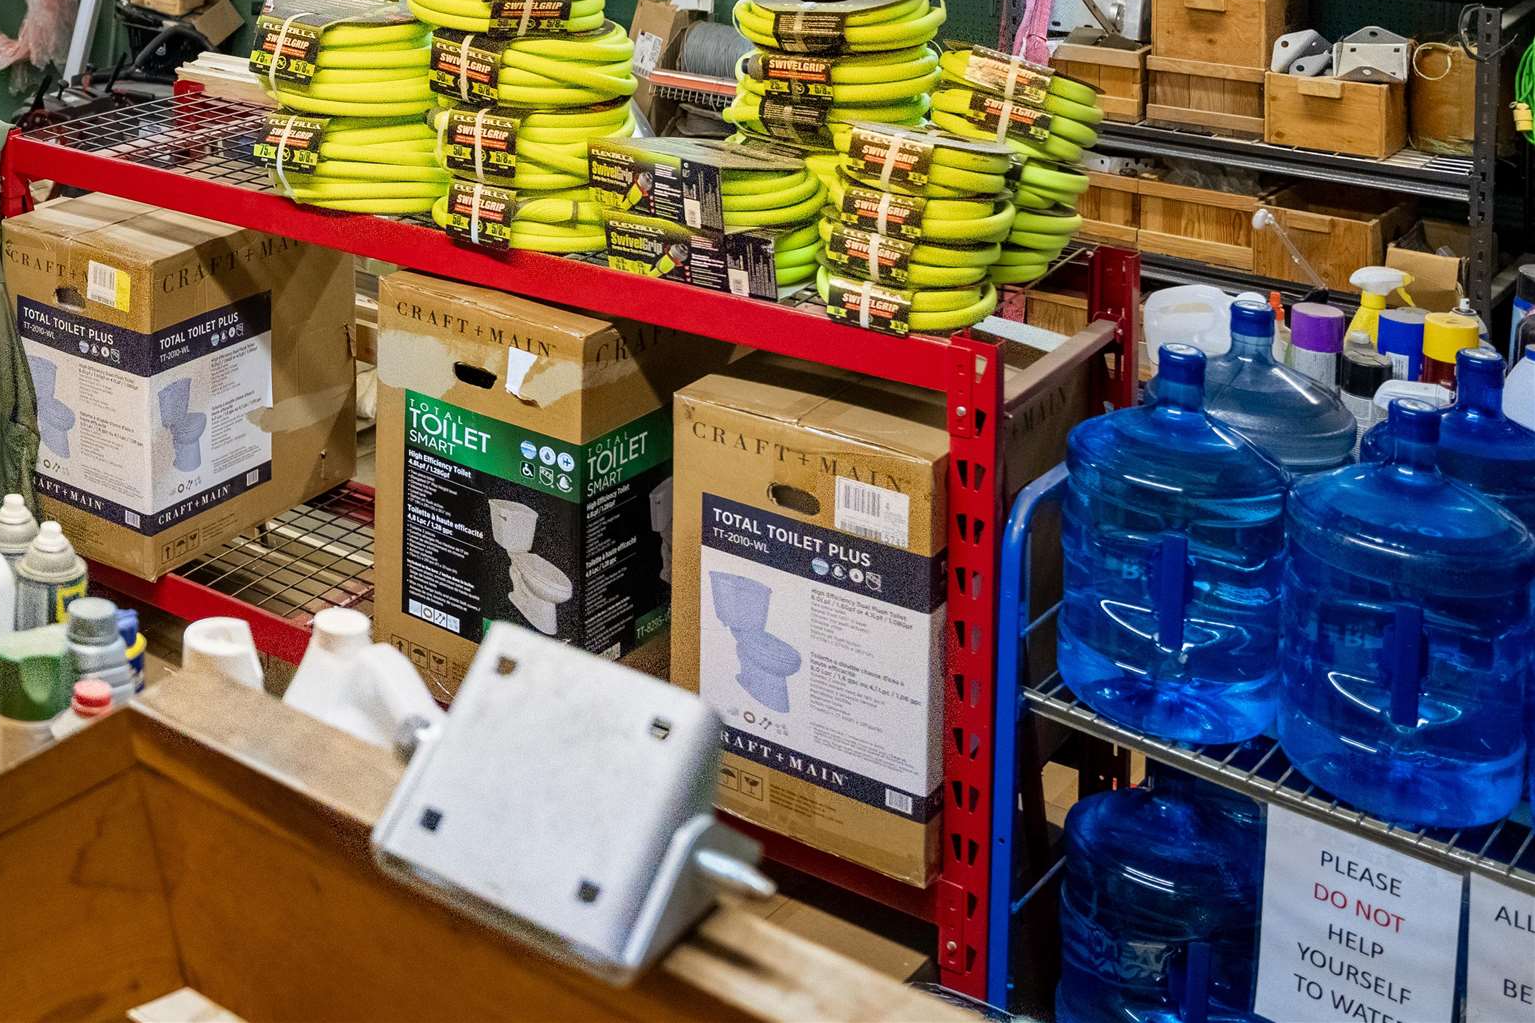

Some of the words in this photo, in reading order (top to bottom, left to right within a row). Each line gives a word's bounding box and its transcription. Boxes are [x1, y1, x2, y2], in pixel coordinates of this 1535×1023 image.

[768, 59, 826, 72] SWIVELGRIP
[591, 161, 633, 183] SwivelGrip
[610, 232, 663, 254] SwivelGrip
[23, 307, 51, 326] TOTAL
[52, 317, 86, 337] TOILET
[88, 329, 114, 345] PLUS
[159, 332, 186, 350] TOTAL
[187, 320, 217, 340] TOILET
[218, 312, 239, 327] PLUS
[397, 301, 469, 334] CRAFT
[489, 327, 551, 358] MAIN
[409, 398, 463, 424] TOTAL
[409, 407, 491, 453] TOILET
[409, 429, 456, 456] SMART
[587, 431, 630, 458] TOTAL
[693, 421, 790, 462] CRAFT
[408, 449, 423, 462] High
[423, 454, 453, 473] Efficiency
[454, 466, 472, 479] Toilet
[586, 431, 649, 481] TOILET
[70, 491, 102, 510] MAIN
[586, 467, 623, 498] SMART
[158, 501, 195, 525] CRAFT
[201, 485, 229, 504] MAIN
[407, 503, 431, 520] Toilette
[431, 512, 436, 520] à
[436, 514, 454, 527] haute
[454, 520, 484, 539] efficacité
[712, 526, 770, 554] TT-2010-WL
[713, 508, 762, 535] TOTAL
[766, 525, 823, 553] TOILET
[828, 543, 871, 567] PLUS
[720, 730, 771, 758] RAFT
[789, 755, 843, 786] MAIN
[1320, 850, 1402, 897] PLEASE
[1313, 882, 1348, 909] DO
[1355, 899, 1406, 934] NOT
[1328, 923, 1385, 959] HELP
[1296, 941, 1412, 1005] YOURSELF
[1503, 978, 1533, 1005] BE
[1293, 973, 1324, 1001] TO
[1330, 990, 1406, 1023] WATE
